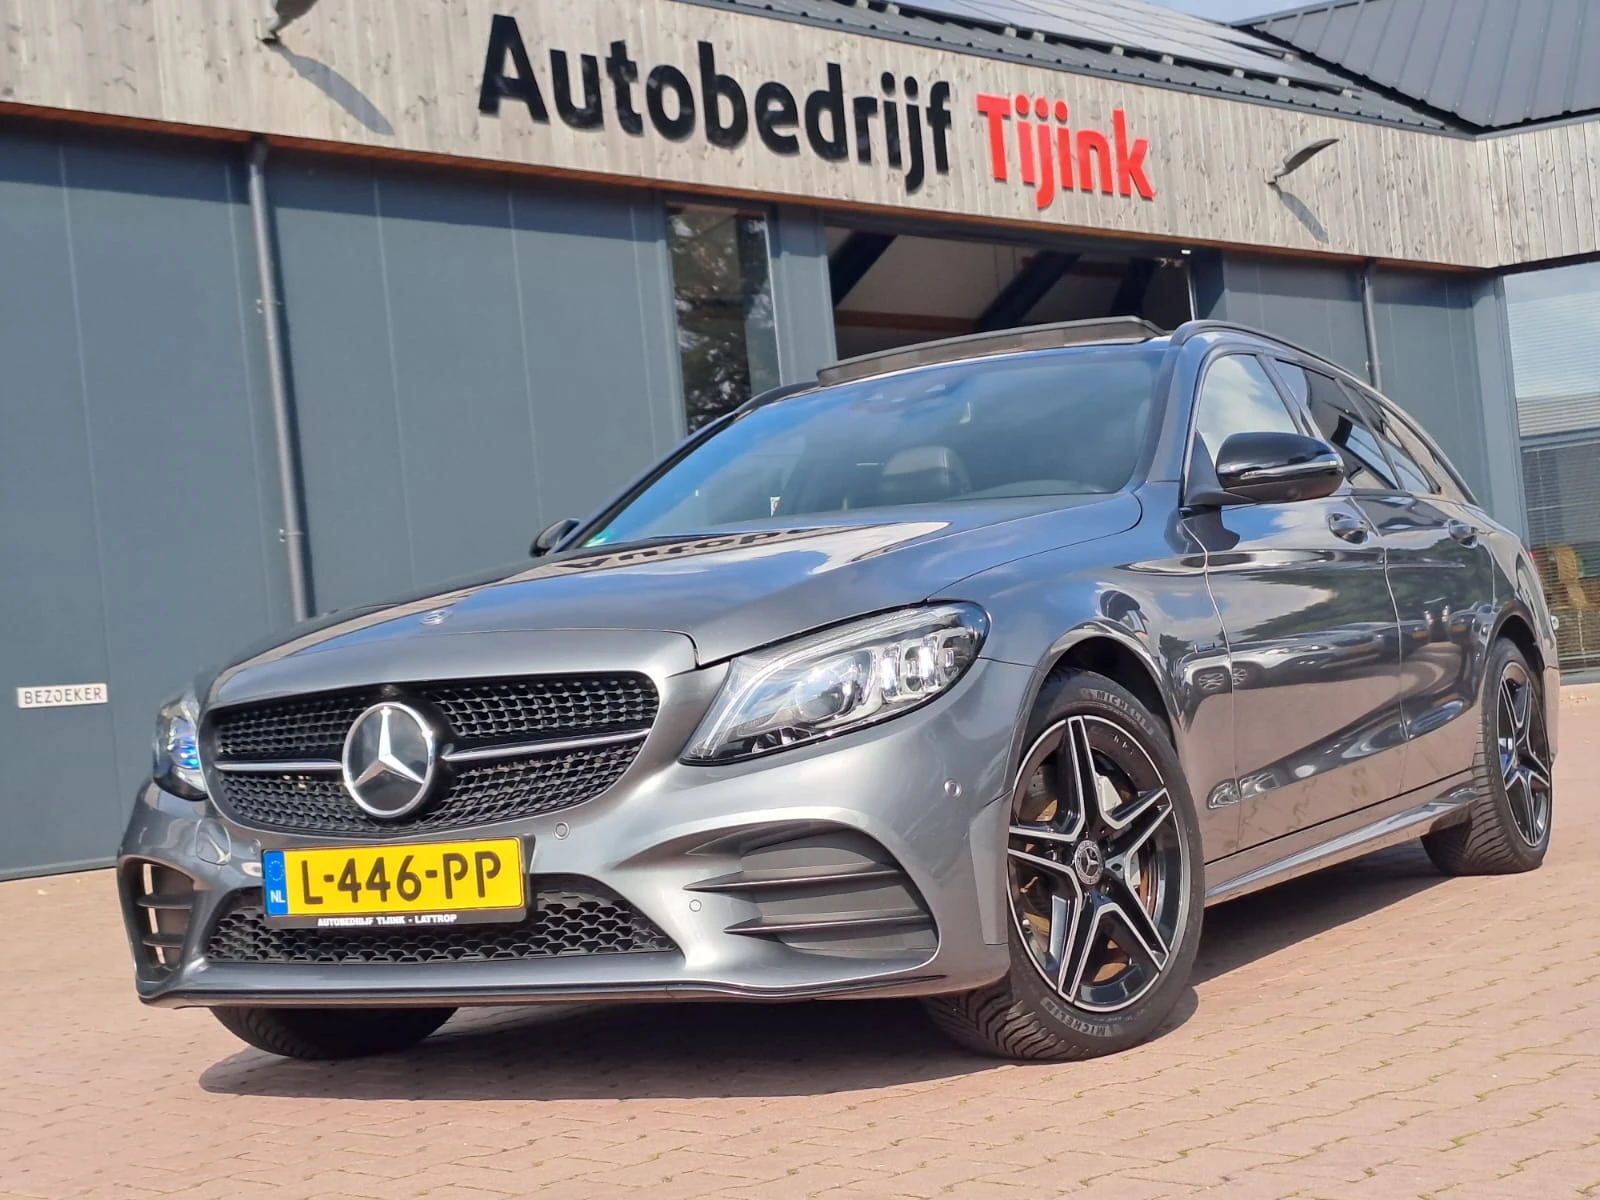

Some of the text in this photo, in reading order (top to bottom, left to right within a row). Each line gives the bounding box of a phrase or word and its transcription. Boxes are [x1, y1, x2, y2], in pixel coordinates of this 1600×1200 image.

[478, 14, 1154, 209] Autobedrijf Tijink
[24, 687, 102, 705] BEZOEKER
[301, 850, 502, 905] L-446-PP
[270, 890, 286, 904] NL
[415, 914, 457, 924] LATTROP
